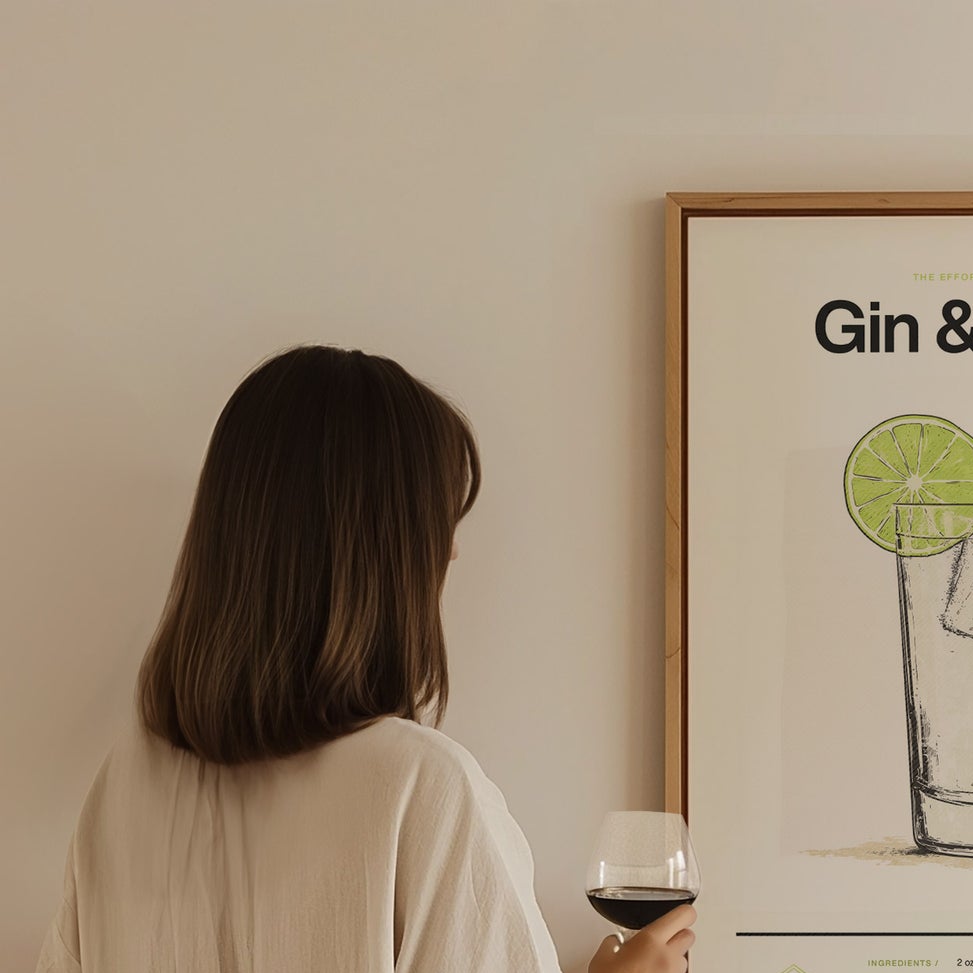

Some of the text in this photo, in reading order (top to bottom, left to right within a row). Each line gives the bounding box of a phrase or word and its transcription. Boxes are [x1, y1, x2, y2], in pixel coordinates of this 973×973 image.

[912, 271, 936, 282] THE
[814, 299, 919, 355] Gin
[866, 958, 932, 968] INGREDIENTS
[956, 957, 963, 967] 2
